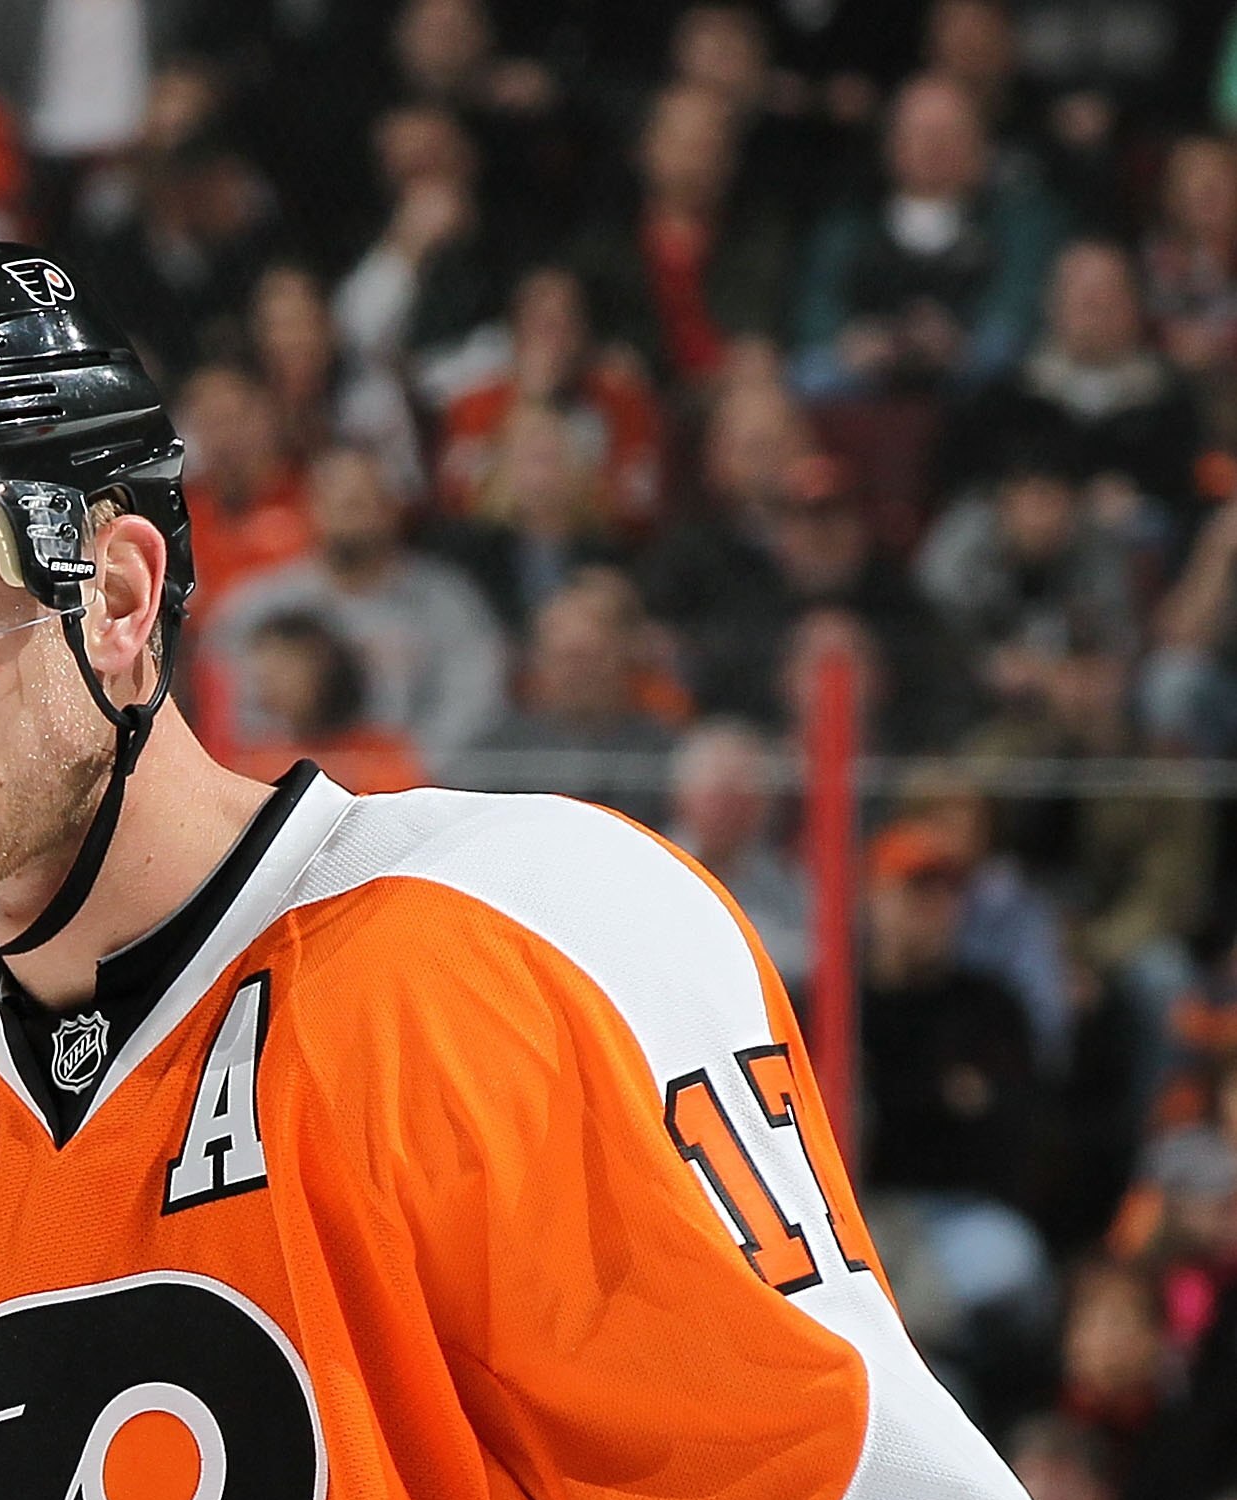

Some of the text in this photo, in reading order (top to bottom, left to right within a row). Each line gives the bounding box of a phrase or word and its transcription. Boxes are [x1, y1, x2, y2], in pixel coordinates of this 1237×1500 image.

[50, 561, 94, 575] BAUER
[63, 1032, 96, 1077] NHL
[160, 968, 272, 1217] A
[663, 1042, 871, 1297] 17
